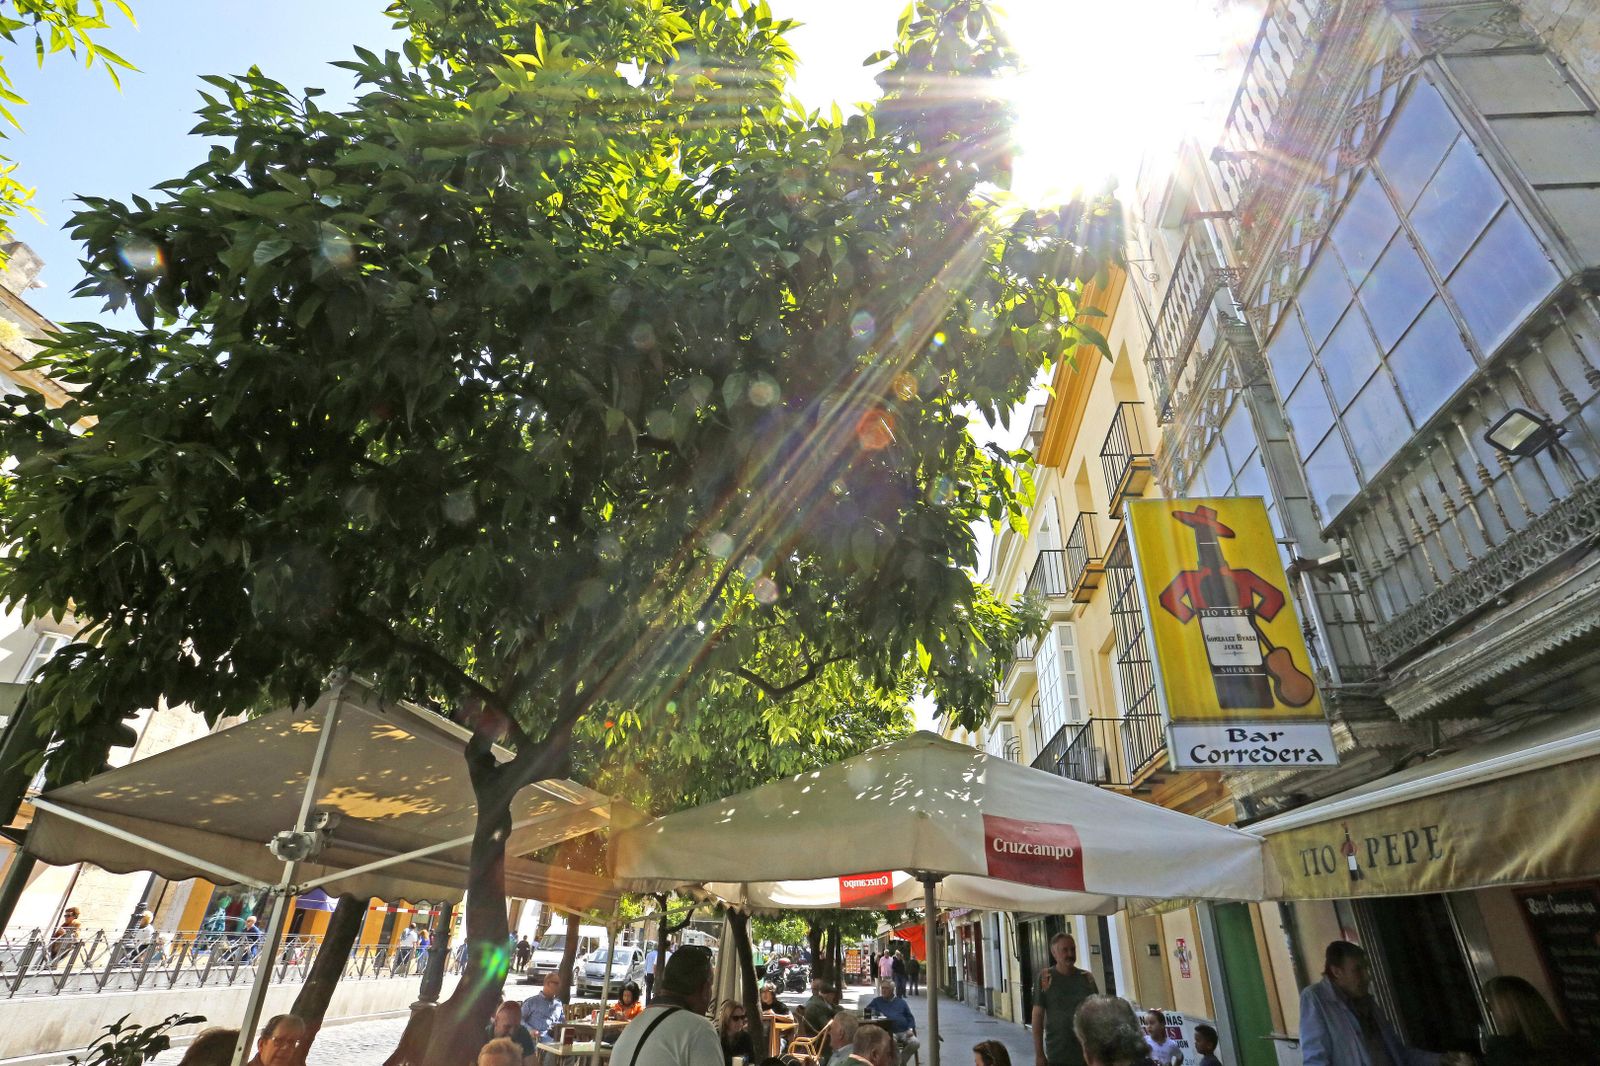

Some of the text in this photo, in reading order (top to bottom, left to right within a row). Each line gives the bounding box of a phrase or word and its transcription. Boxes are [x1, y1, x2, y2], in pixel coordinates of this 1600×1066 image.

[1200, 609, 1250, 617] TIO PEPE
[1225, 728, 1285, 743] Bar
[1189, 744, 1324, 764] Corredera
[992, 837, 1074, 859] Cruzcampo
[1299, 825, 1443, 877] TIO PEPE
